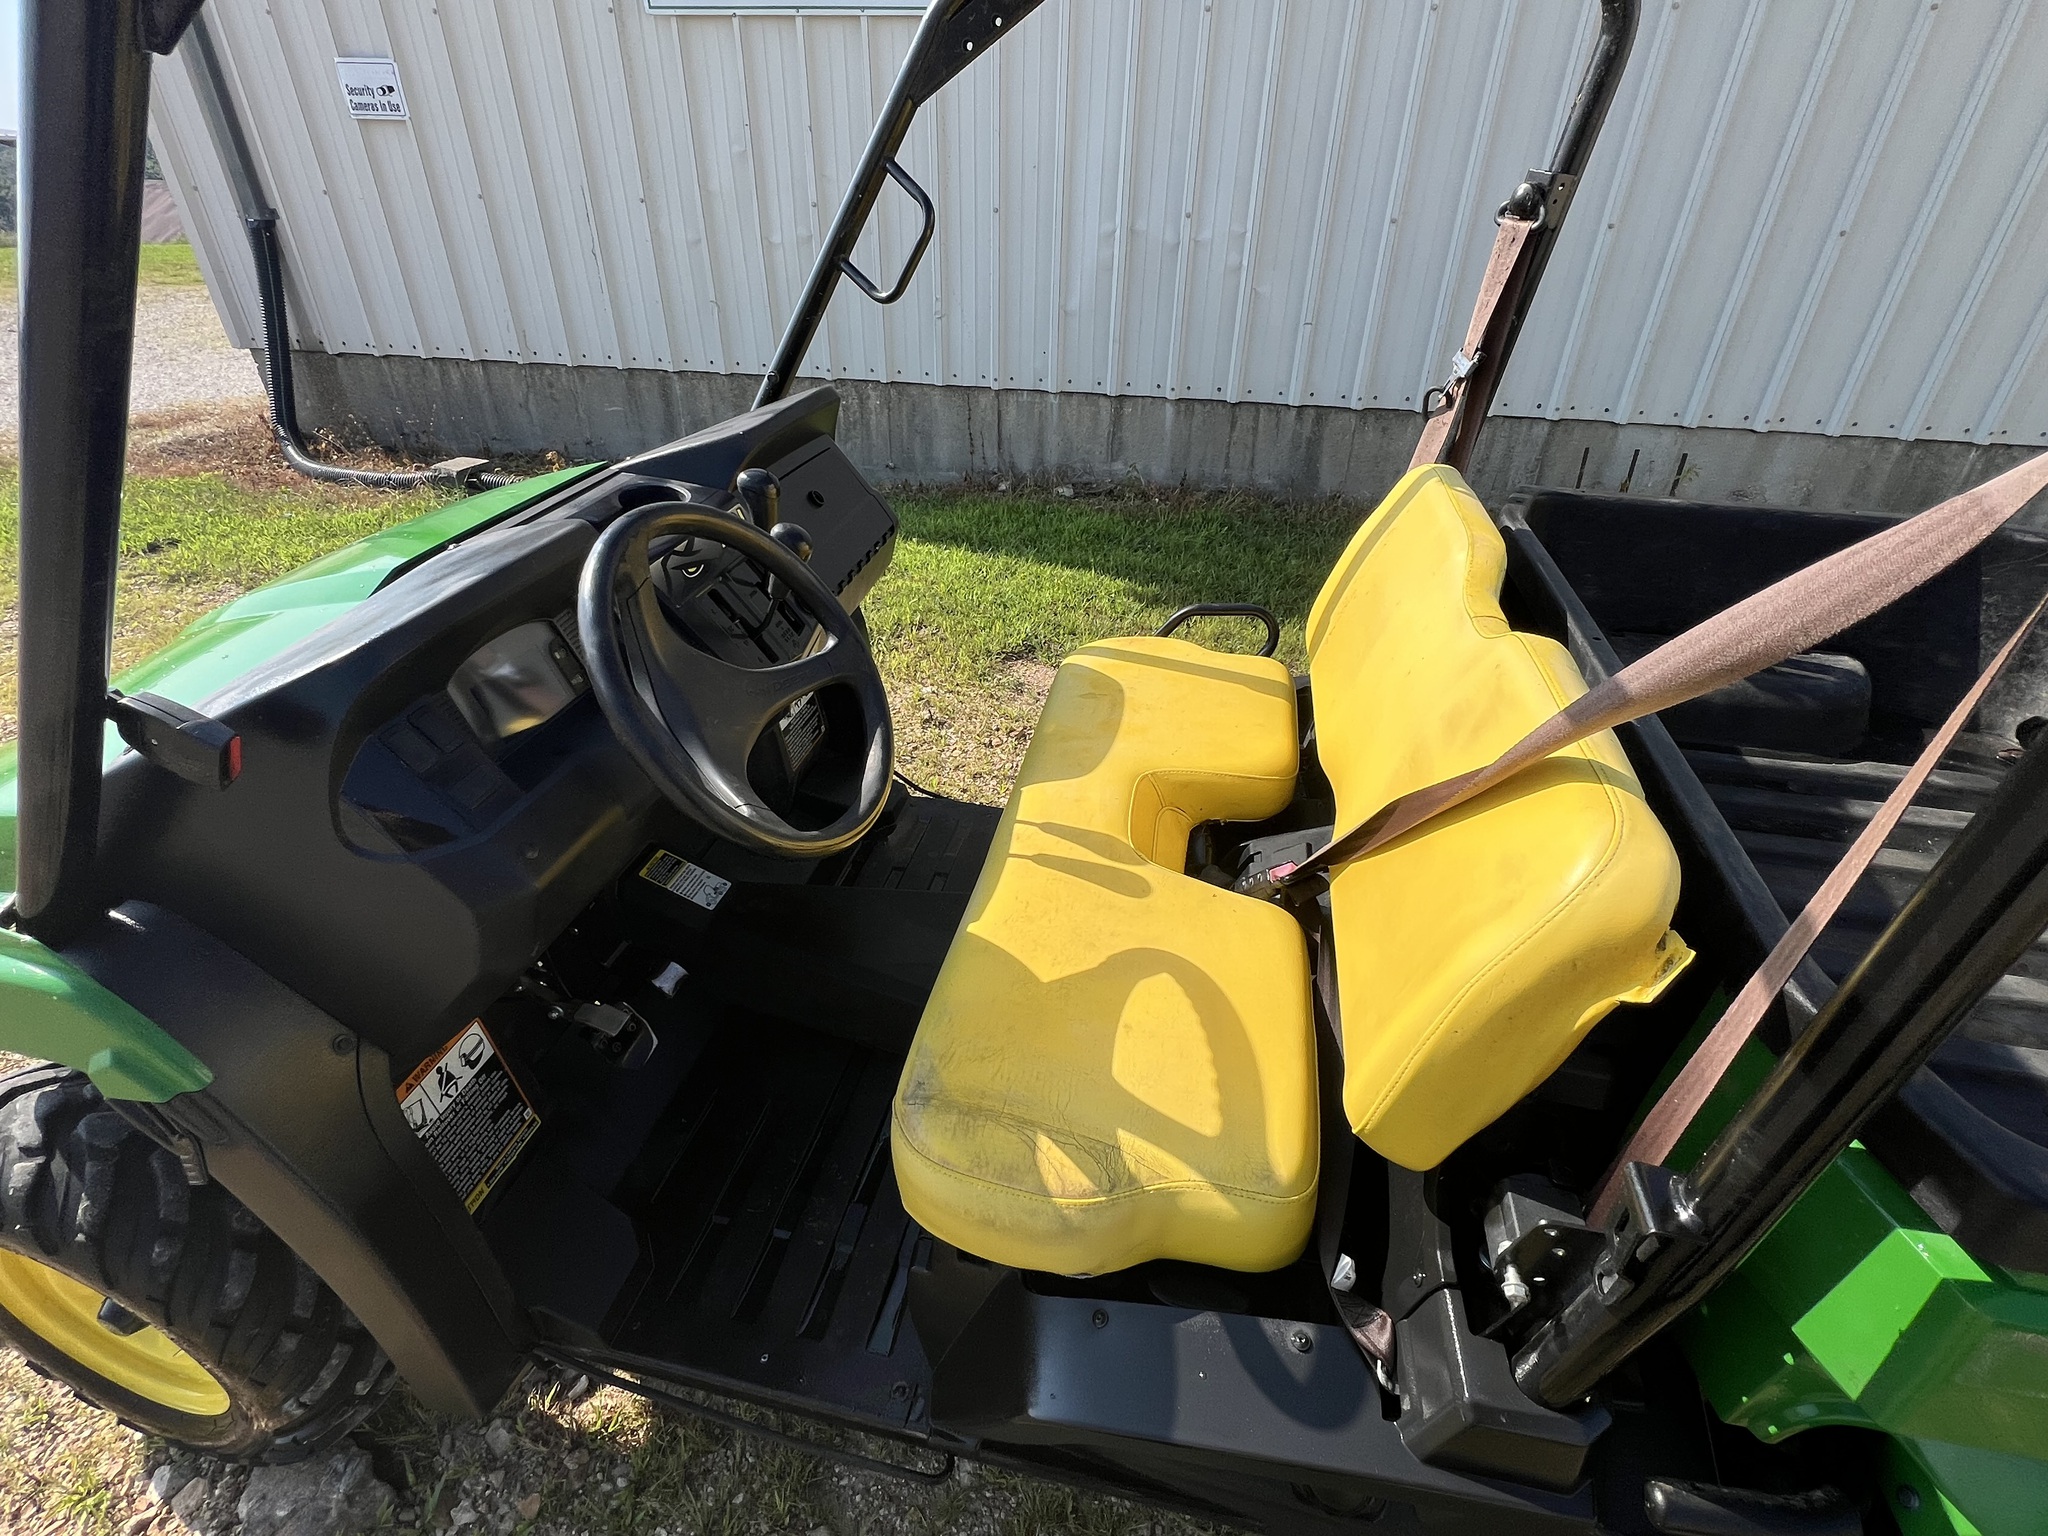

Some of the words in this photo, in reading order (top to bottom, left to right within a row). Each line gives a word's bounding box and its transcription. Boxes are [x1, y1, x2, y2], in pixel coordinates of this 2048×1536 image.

[345, 83, 375, 99] Security
[349, 98, 379, 112] Cameras
[379, 100, 388, 112] In
[387, 100, 402, 113] Use
